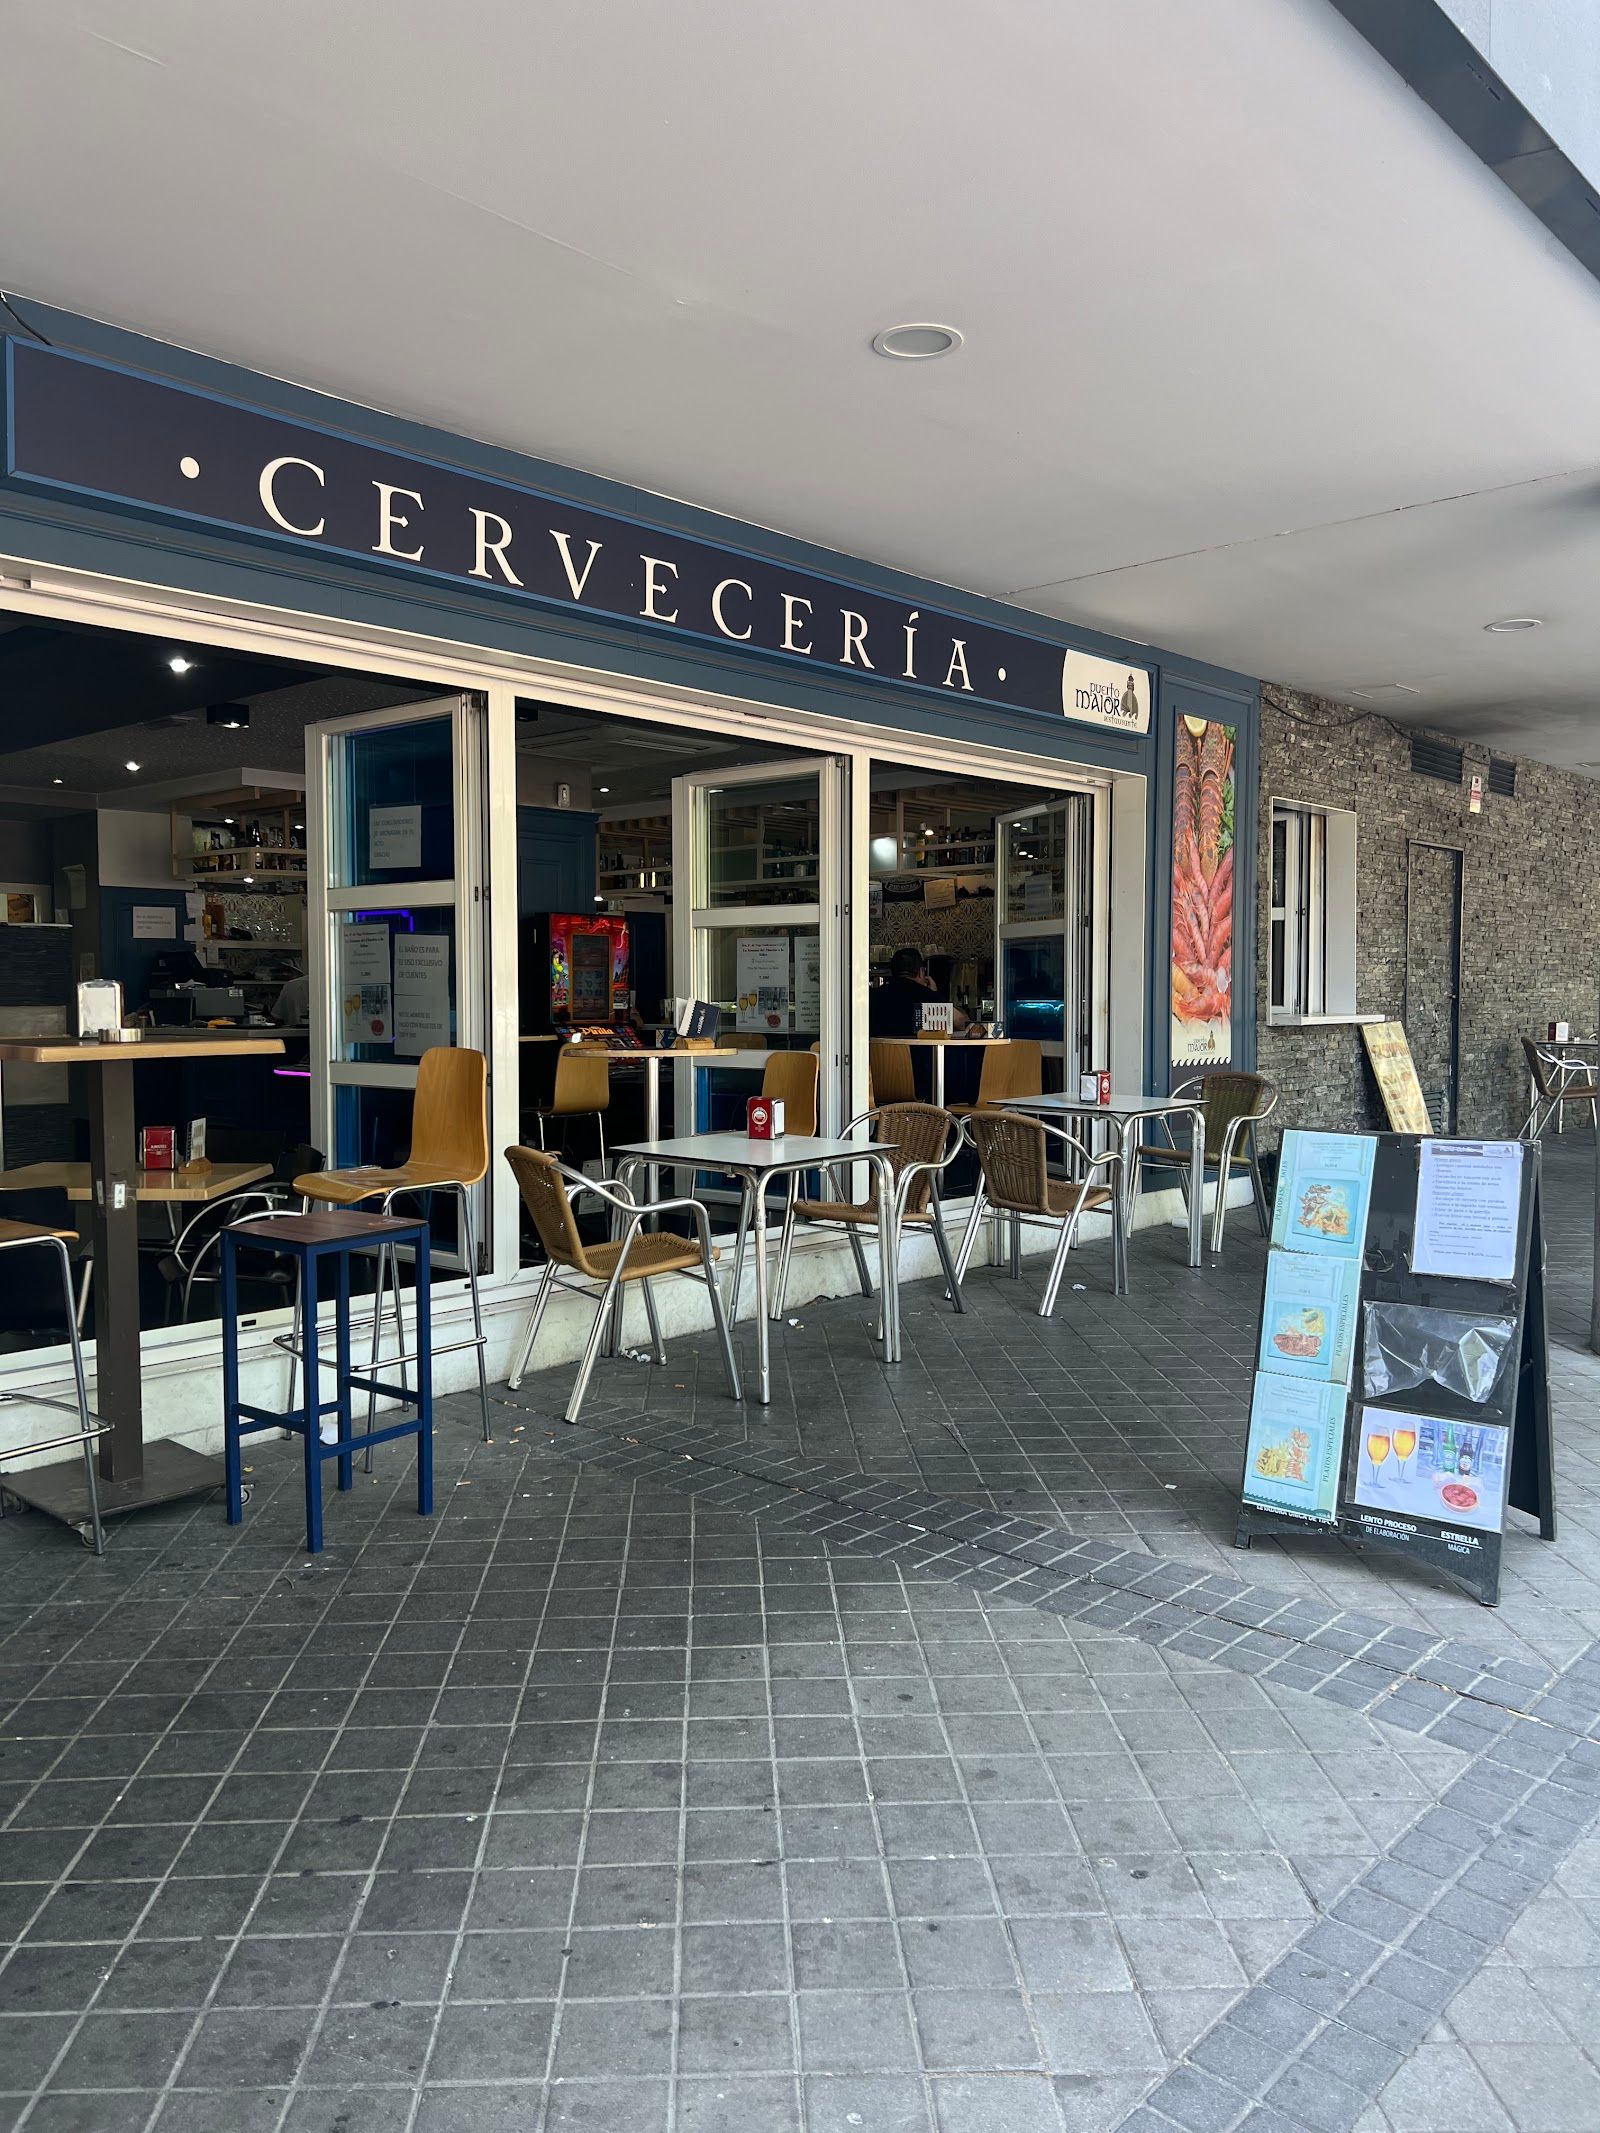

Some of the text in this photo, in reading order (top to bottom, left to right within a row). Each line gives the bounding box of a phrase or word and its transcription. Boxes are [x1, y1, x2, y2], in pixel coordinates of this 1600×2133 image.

[257, 456, 974, 692] CERVECERÍA
[1360, 1514, 1417, 1533] LENTO PROCESO
[1365, 1526, 1374, 1534] DE
[1441, 1531, 1480, 1546] ESTRELLA
